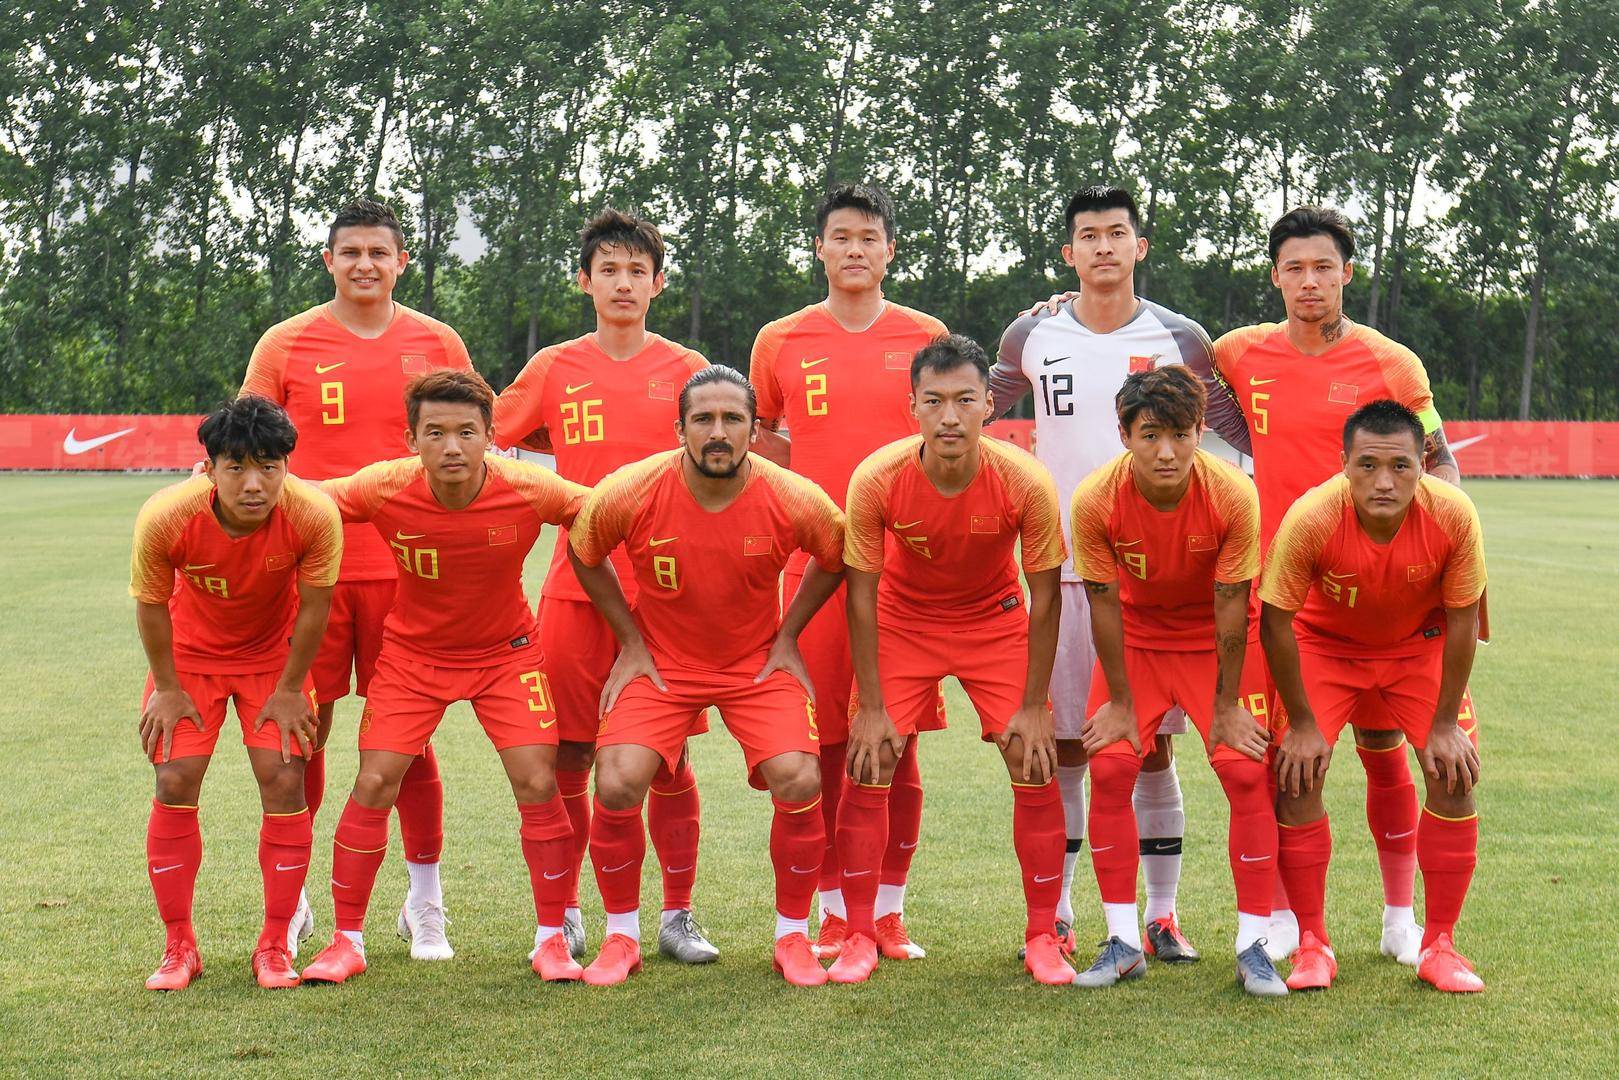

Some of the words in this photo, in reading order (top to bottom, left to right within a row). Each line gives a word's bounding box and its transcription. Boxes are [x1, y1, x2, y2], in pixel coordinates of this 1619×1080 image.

[320, 381, 346, 425] 9
[805, 373, 828, 416] 2
[1039, 374, 1074, 416] 12
[1250, 392, 1271, 435] 5
[559, 398, 605, 446] 26
[653, 555, 679, 591] 8
